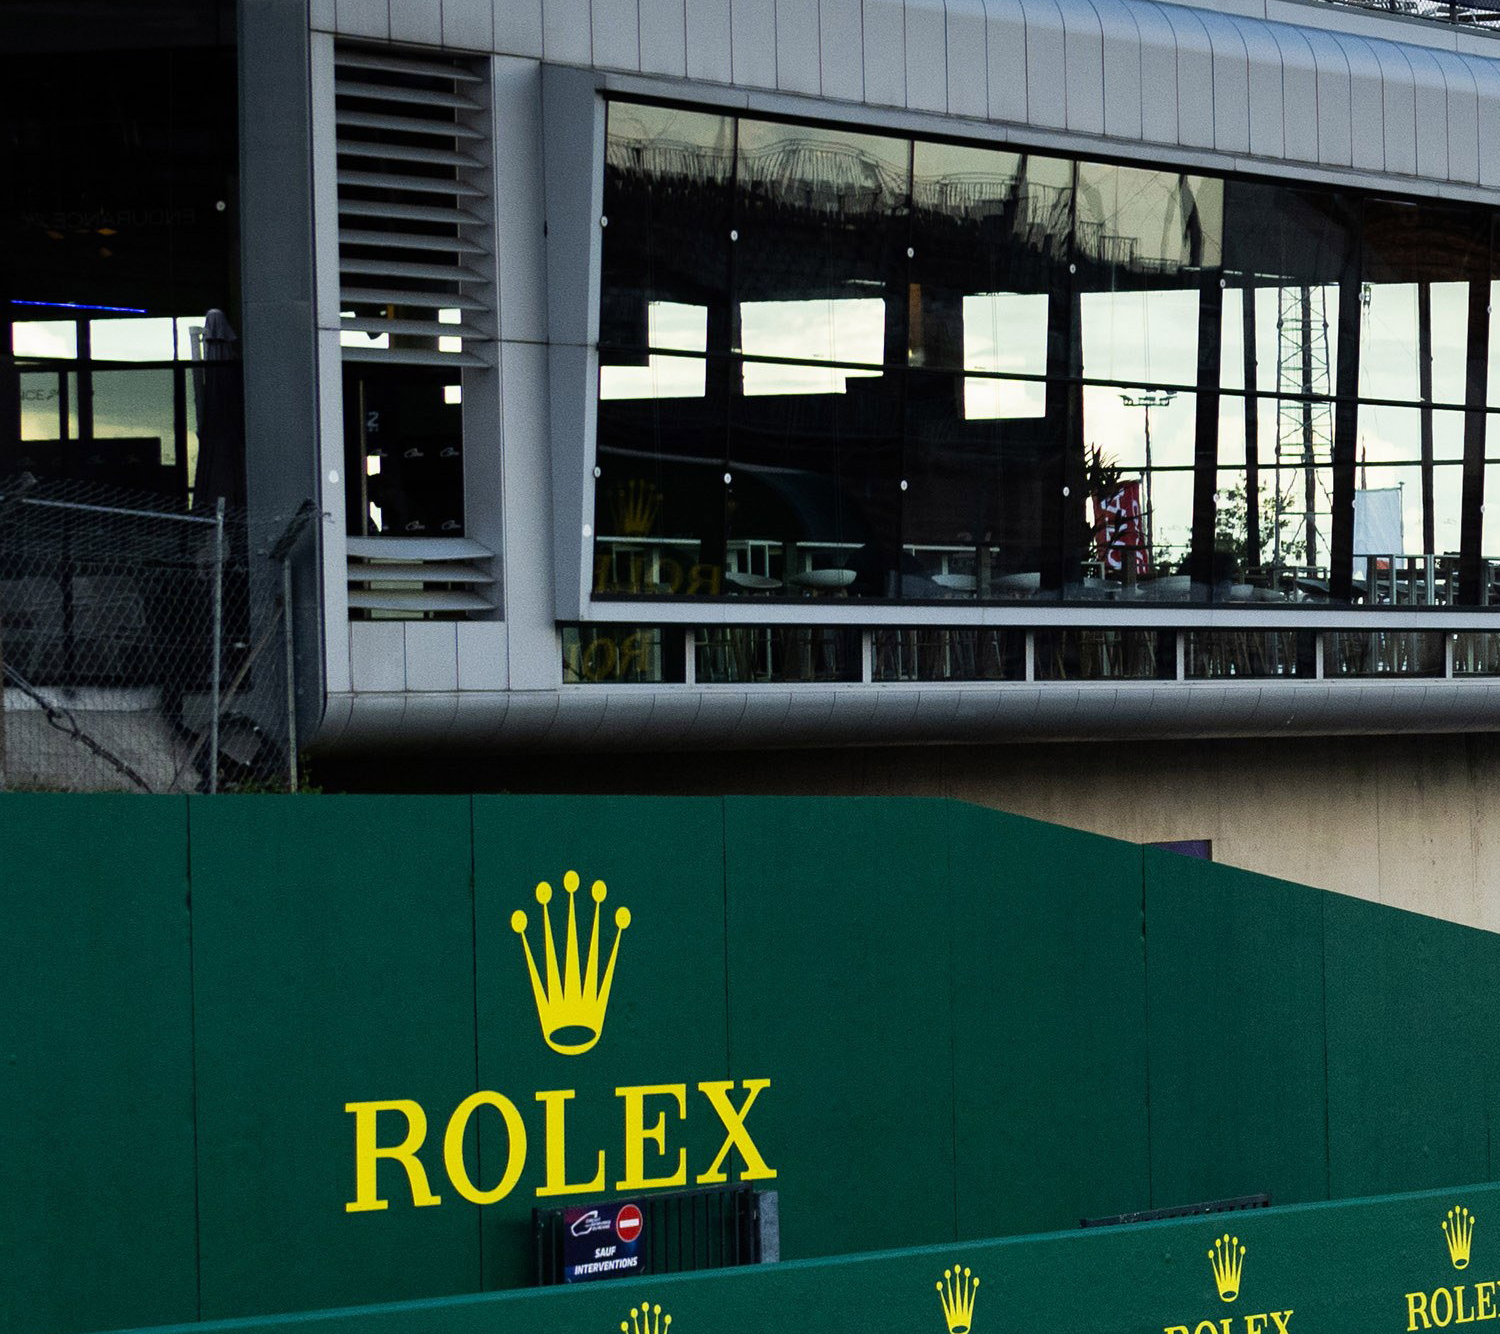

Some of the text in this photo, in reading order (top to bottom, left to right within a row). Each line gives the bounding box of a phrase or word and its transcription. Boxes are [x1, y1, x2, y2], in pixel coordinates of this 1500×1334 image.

[344, 1078, 777, 1212] ROLEX
[595, 1246, 616, 1259] SAUF
[574, 1256, 638, 1275] INTERVENTIONS
